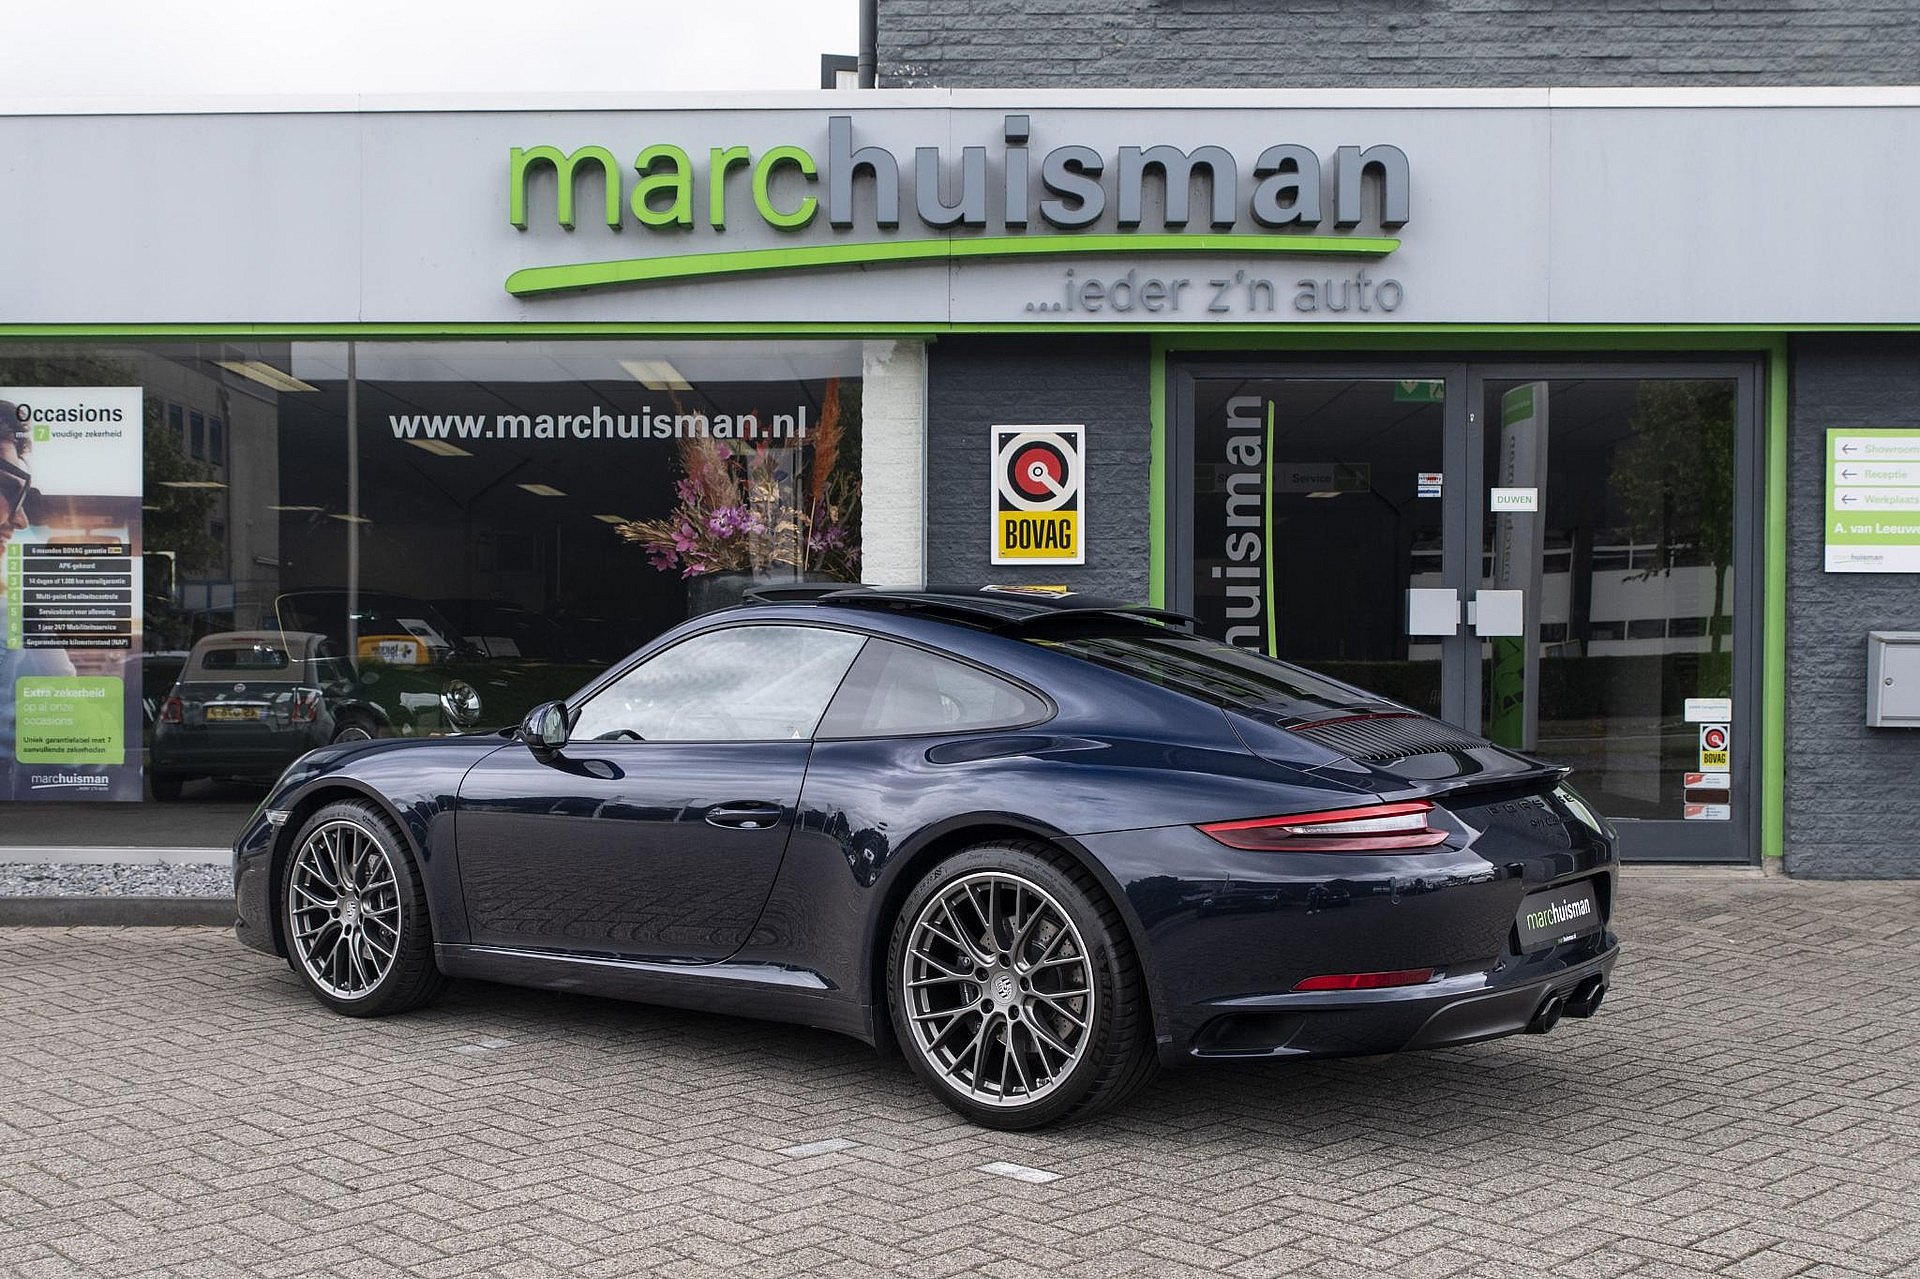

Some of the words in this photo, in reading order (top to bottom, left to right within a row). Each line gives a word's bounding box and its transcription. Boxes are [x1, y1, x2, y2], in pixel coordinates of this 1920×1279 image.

[509, 115, 1411, 232] marchuisman
[1208, 270, 1274, 313] z'n
[1296, 276, 1403, 313] auto
[16, 403, 123, 422] Occasions
[389, 406, 806, 439] www.marchuisman.nl
[51, 430, 83, 439] voudige
[84, 429, 122, 438] zekerheid
[1292, 472, 1332, 483] Service
[1864, 469, 1907, 480] Receptie
[1497, 496, 1532, 504] DUWEN
[1864, 494, 1919, 505] Werkplaats
[1005, 519, 1071, 549] BOVAG
[1835, 523, 1847, 534] A.
[1850, 525, 1872, 534] van
[1876, 523, 1920, 534] Leeuw
[23, 687, 52, 698] Extra
[53, 687, 105, 698] zekerheid
[23, 704, 37, 713] op
[49, 704, 74, 712] onze
[23, 736, 43, 744] Uniek
[45, 736, 90, 745] garantielabel
[1703, 753, 1726, 764] BOVAG
[31, 773, 109, 784] marchuisman
[1526, 897, 1591, 931] marchuisman
